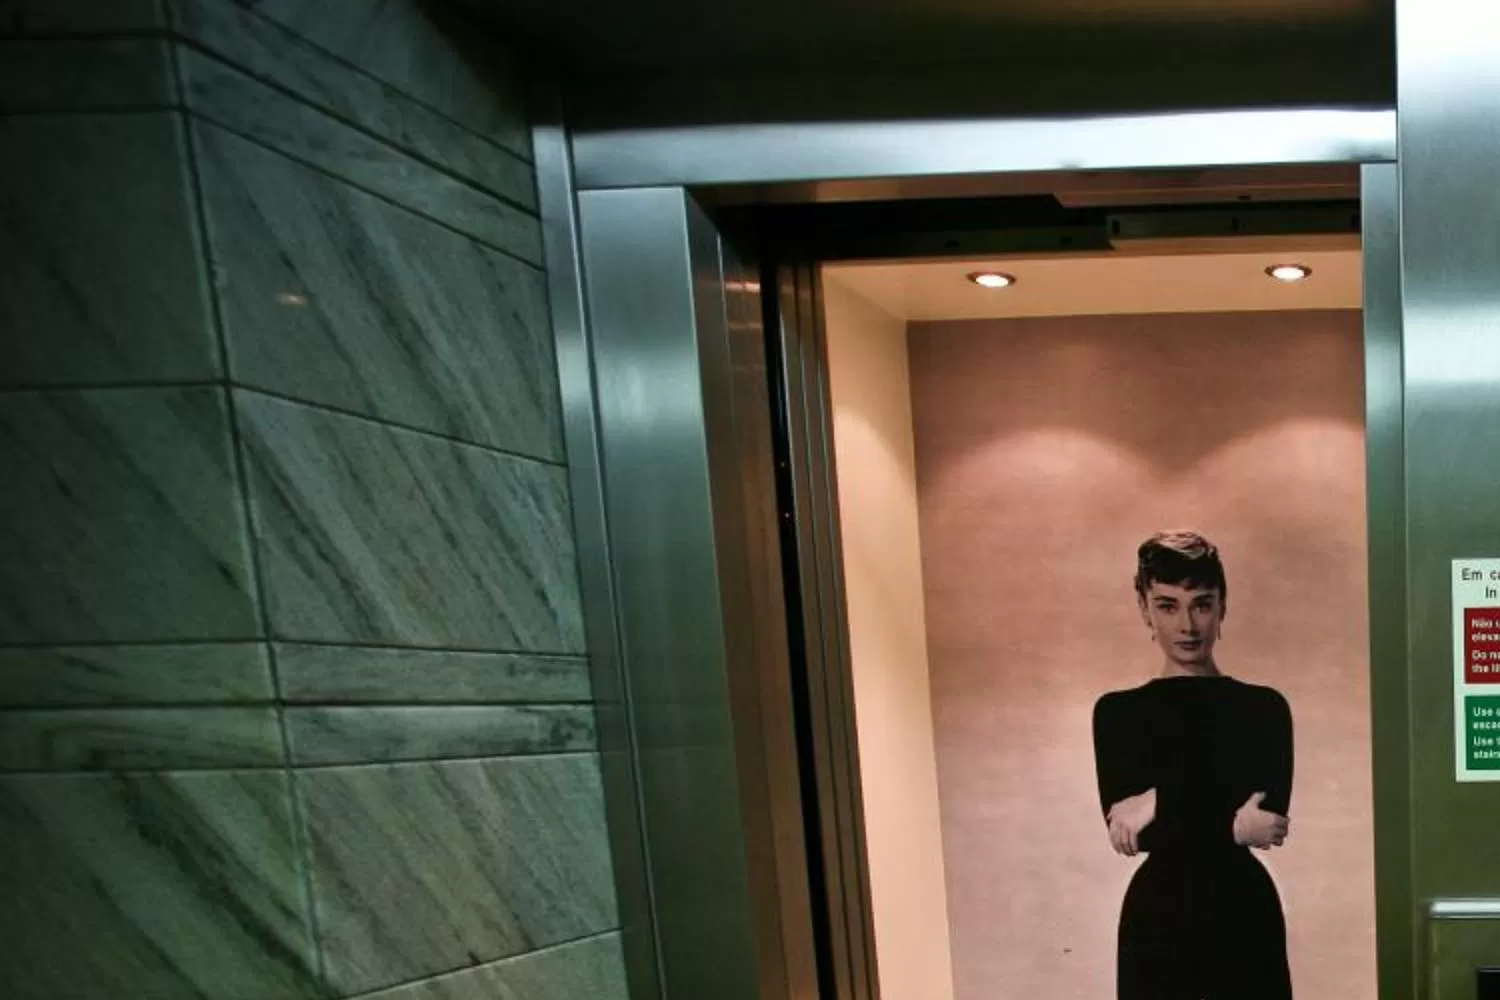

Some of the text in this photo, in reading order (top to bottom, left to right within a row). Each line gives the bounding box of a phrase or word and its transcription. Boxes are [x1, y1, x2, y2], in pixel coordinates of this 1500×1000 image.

[1461, 567, 1483, 581] Em
[1485, 587, 1497, 599] In
[1471, 618, 1493, 628] Não
[1471, 650, 1487, 660] Do
[1471, 663, 1489, 673] the
[1473, 707, 1493, 717] Use
[1473, 736, 1494, 747] Use
